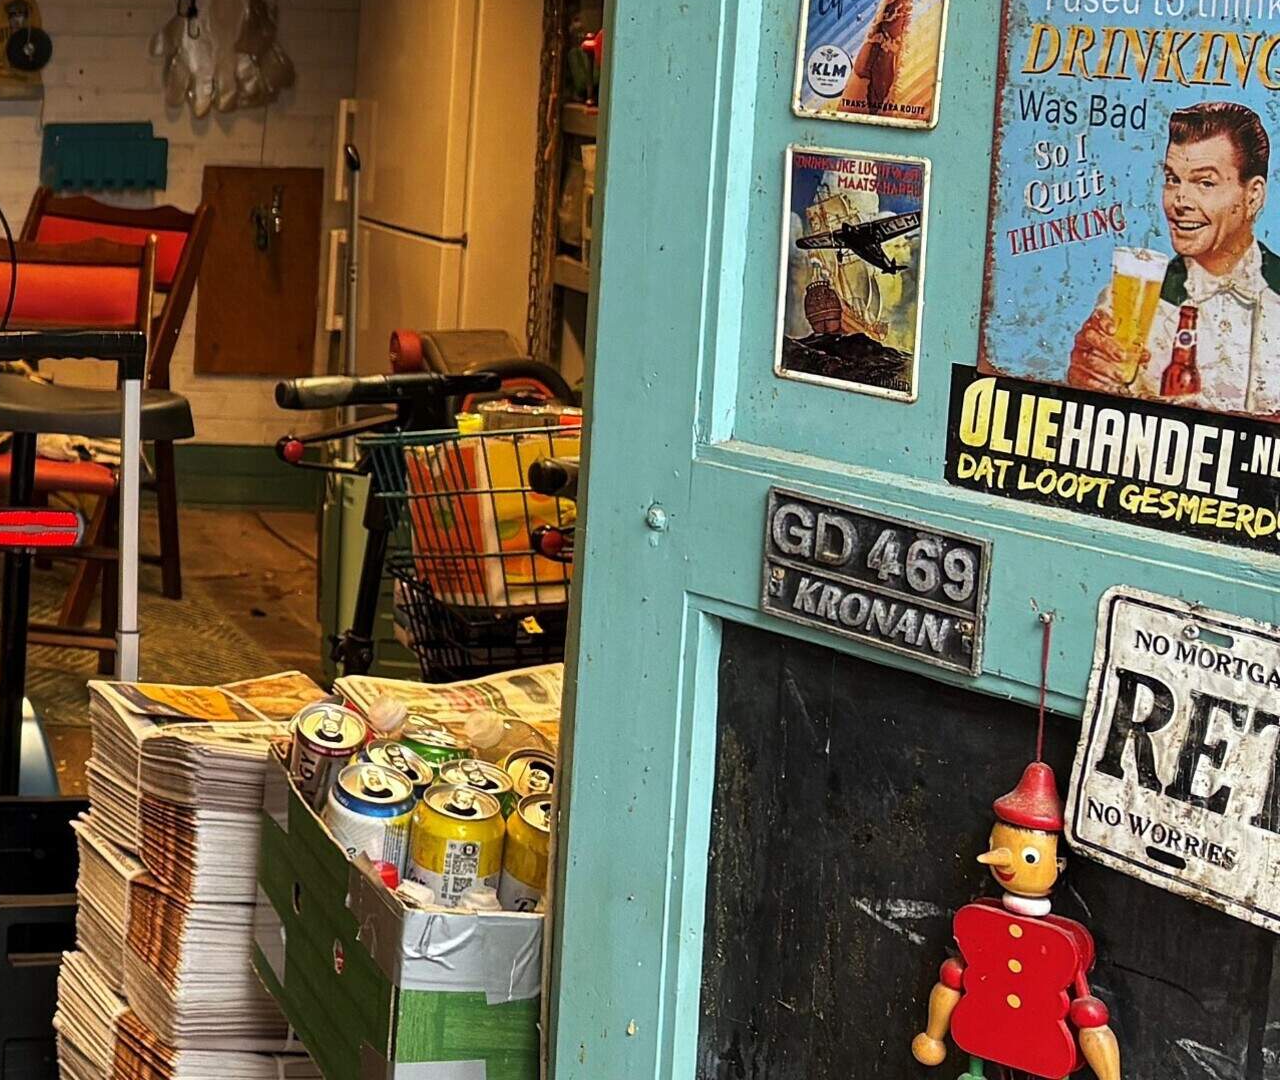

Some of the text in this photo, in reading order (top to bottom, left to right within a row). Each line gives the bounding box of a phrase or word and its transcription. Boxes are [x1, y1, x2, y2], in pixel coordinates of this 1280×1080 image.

[811, 62, 847, 78] KLM
[1021, 24, 1280, 91] DRINKING
[900, 103, 925, 115] ROUTE
[1019, 89, 1148, 131] Was Bad
[1035, 133, 1088, 171] So I
[1025, 169, 1107, 215] Quit
[882, 214, 918, 233] KLM
[1007, 204, 1126, 256] THINKING
[957, 452, 1014, 490] DAT
[1017, 465, 1115, 509] LOOPT
[772, 499, 977, 603] GD 469
[791, 576, 950, 655] KRONAN
[1134, 630, 1170, 655] NO
[1088, 797, 1238, 867] NO WORRIES
